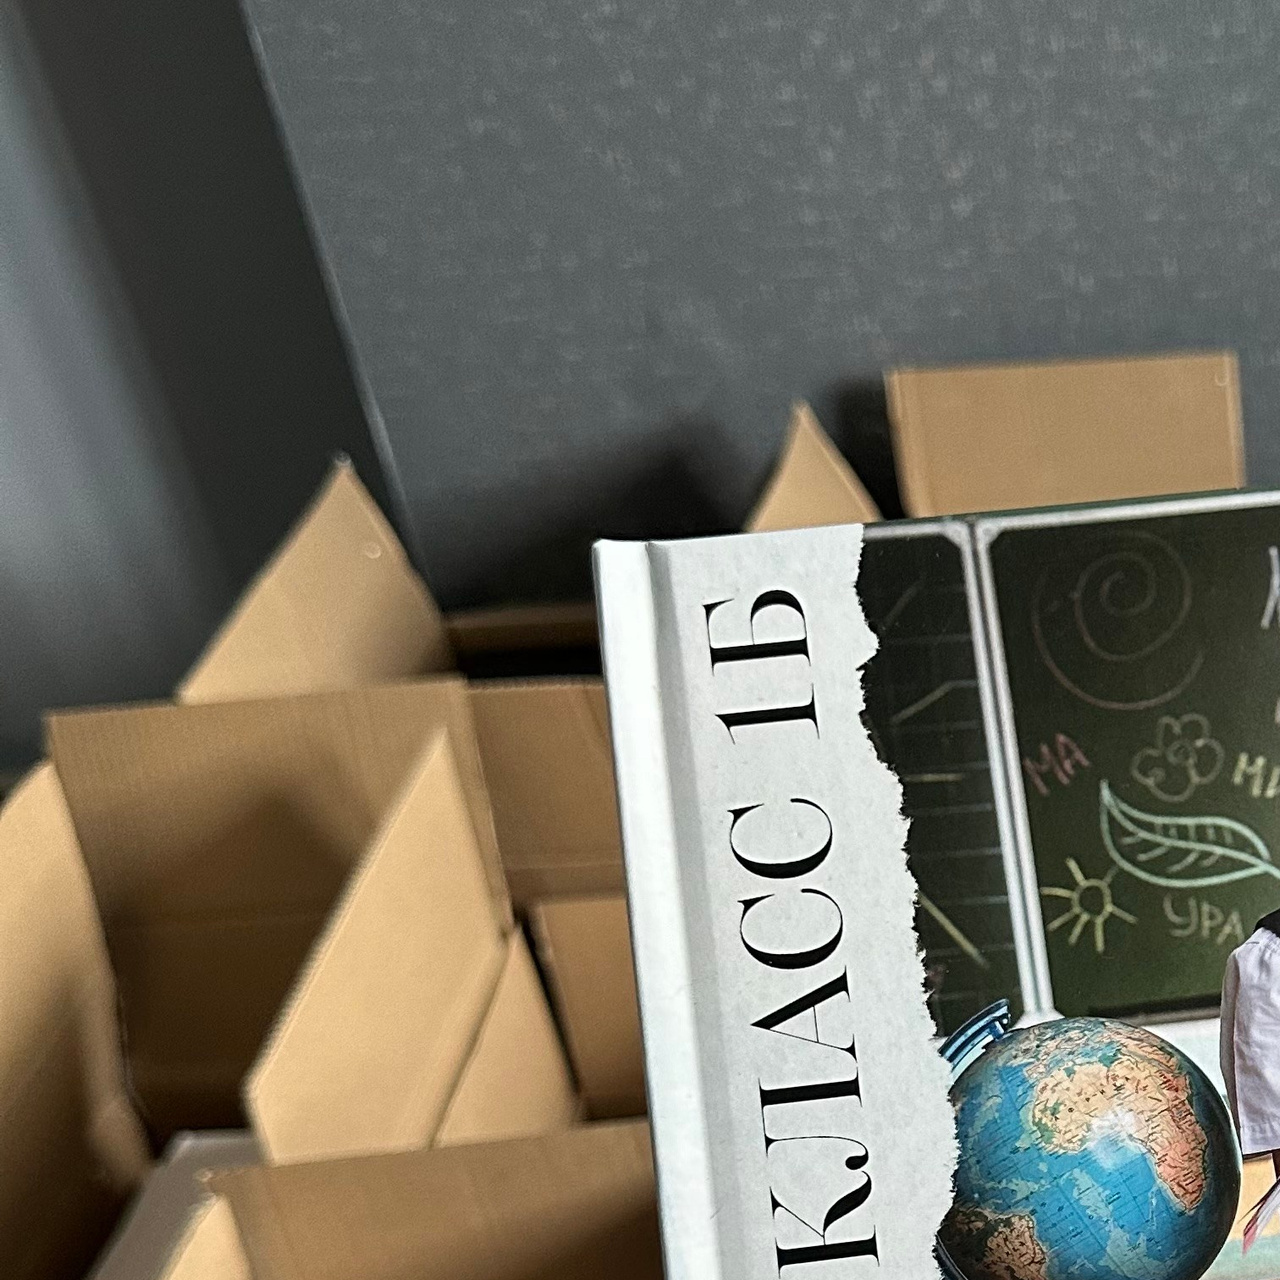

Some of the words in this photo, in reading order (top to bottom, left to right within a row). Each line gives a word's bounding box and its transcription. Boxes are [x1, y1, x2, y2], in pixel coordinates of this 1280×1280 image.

[702, 588, 821, 745] 1Б
[1022, 733, 1091, 797] МА
[1162, 892, 1246, 945] УРА
[727, 796, 881, 1279] КЛАСС
